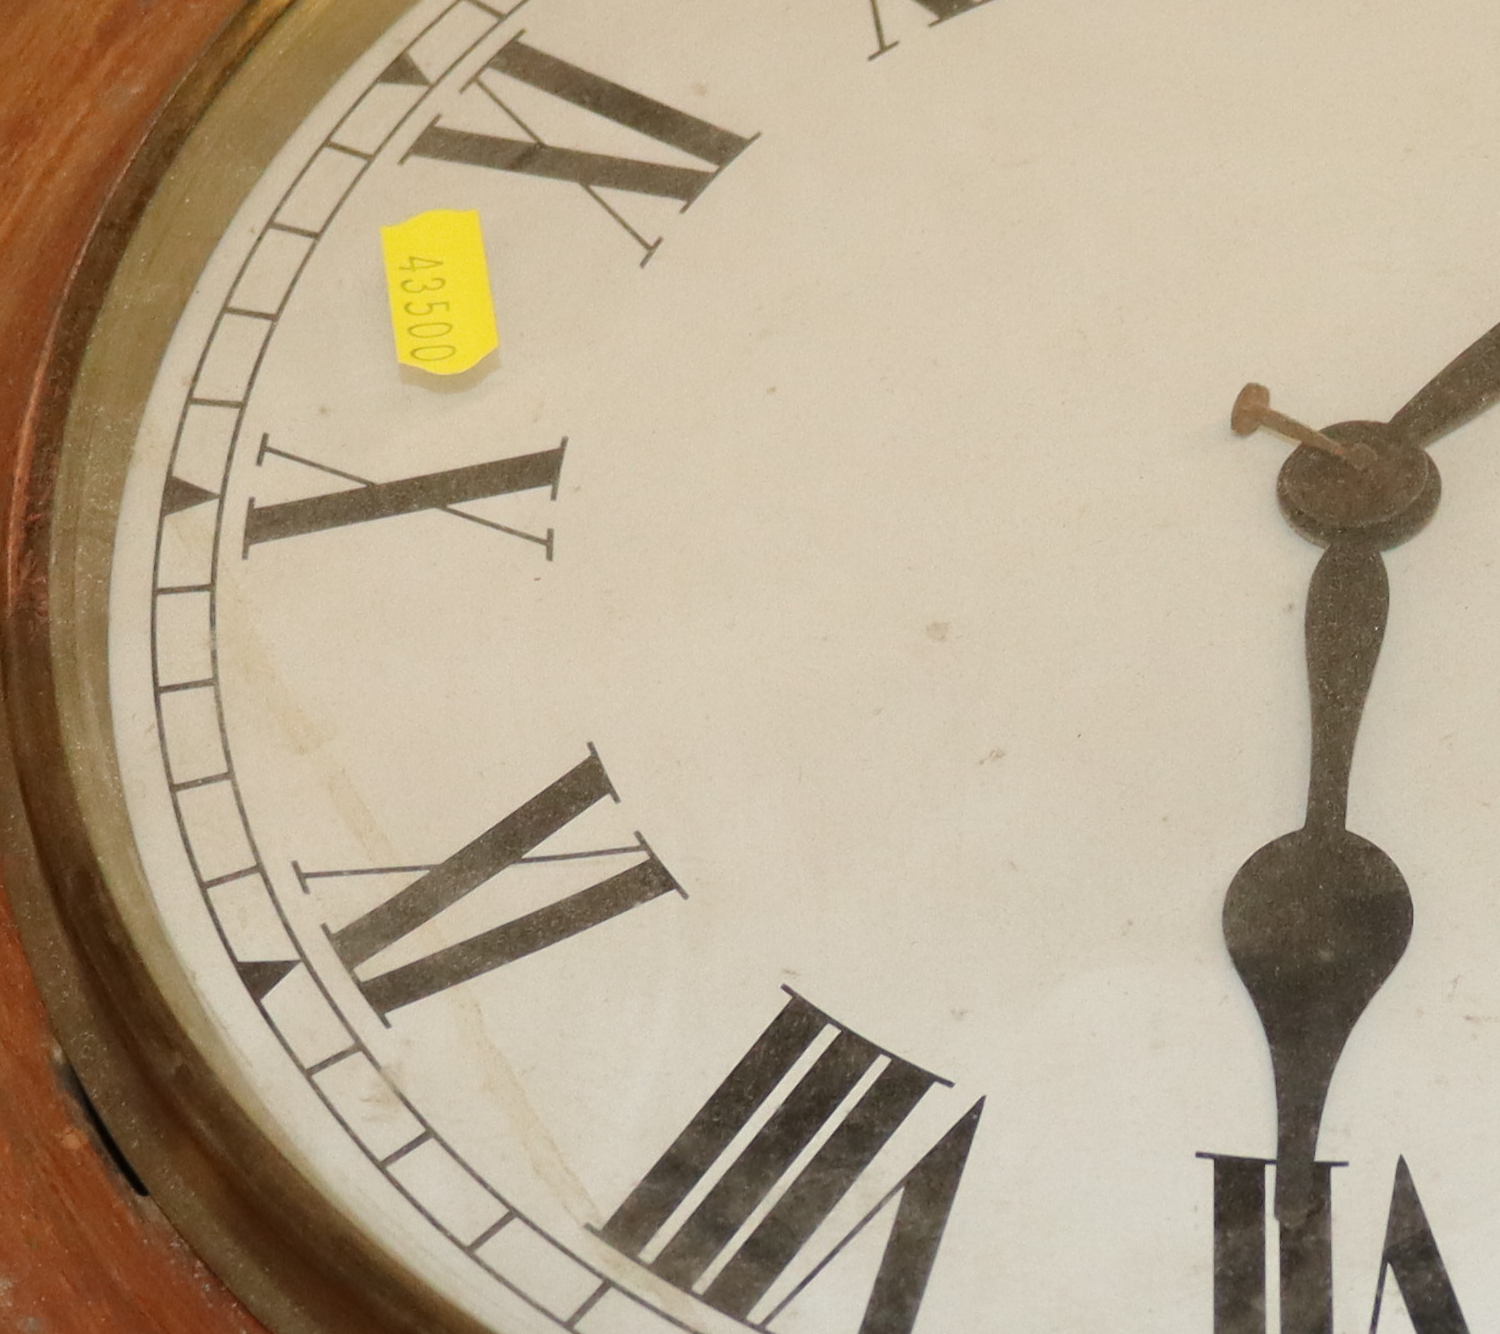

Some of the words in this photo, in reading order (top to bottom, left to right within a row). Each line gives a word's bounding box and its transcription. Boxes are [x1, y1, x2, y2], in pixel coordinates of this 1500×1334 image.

[399, 29, 761, 268] XI
[398, 255, 456, 362] 43500
[241, 436, 569, 562] X
[291, 741, 689, 1028] IX
